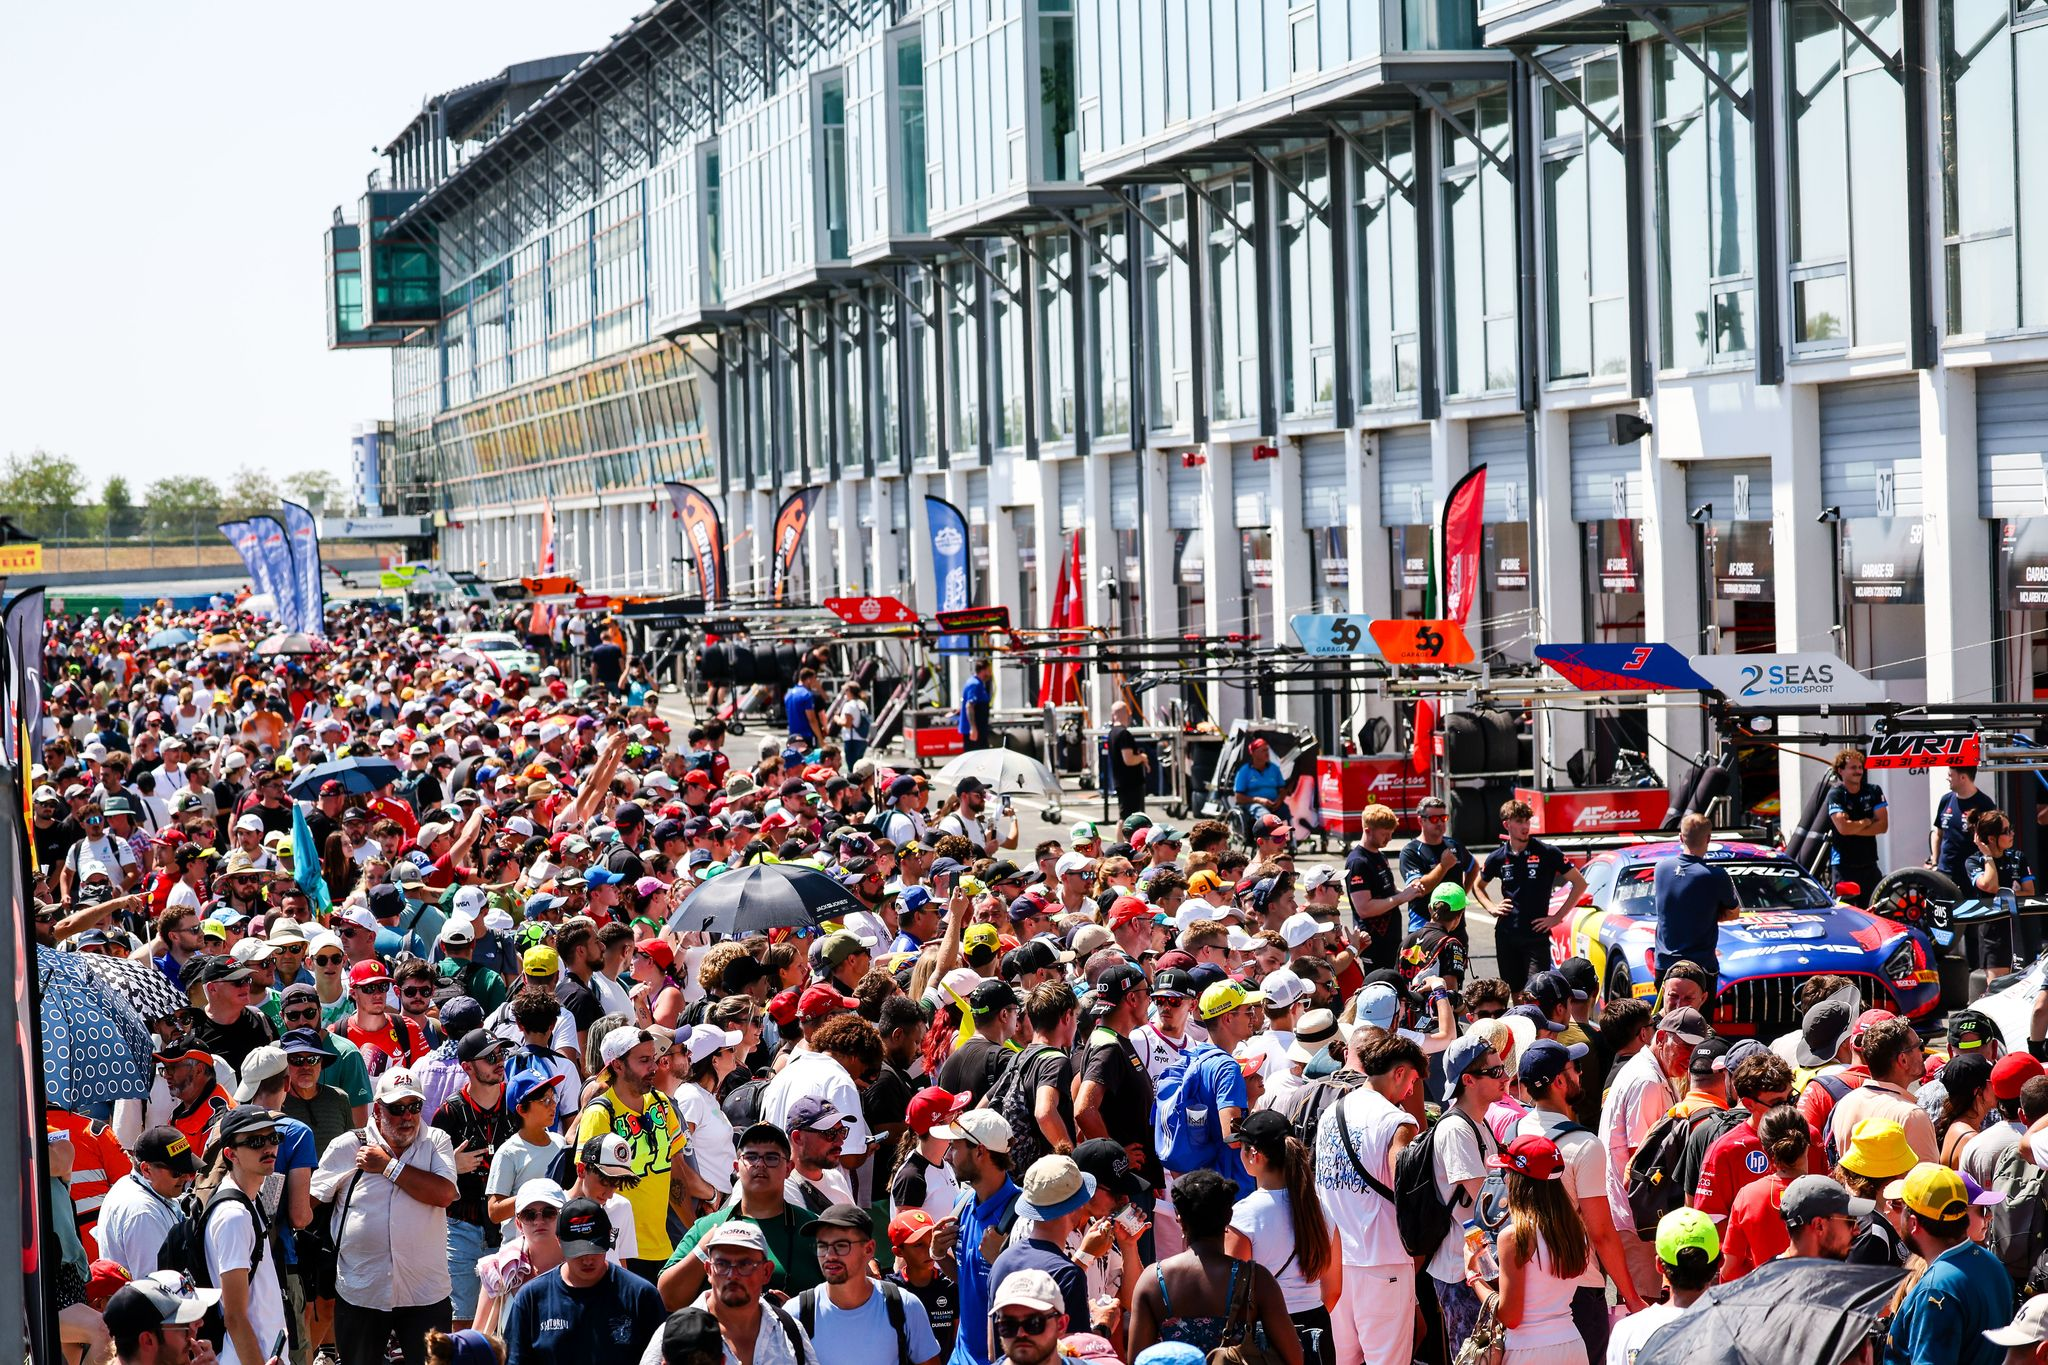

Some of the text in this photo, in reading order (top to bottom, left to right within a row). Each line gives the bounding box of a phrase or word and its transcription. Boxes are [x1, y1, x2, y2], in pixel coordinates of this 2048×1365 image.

[1735, 480, 1748, 515] 36
[1878, 474, 1892, 511] 37
[1861, 564, 1885, 578] GARAGE
[1330, 618, 1361, 651] 59
[1415, 626, 1444, 657] 59
[1623, 647, 1653, 671] 3
[1769, 664, 1834, 684] SEAS
[1769, 685, 1834, 695] MOTORSPORT
[1870, 733, 1977, 757] WRT
[1873, 756, 1965, 768] 30 31 32 46
[1934, 904, 1947, 917] aws
[1959, 1021, 1976, 1030] 46
[1750, 1152, 1765, 1173] hp
